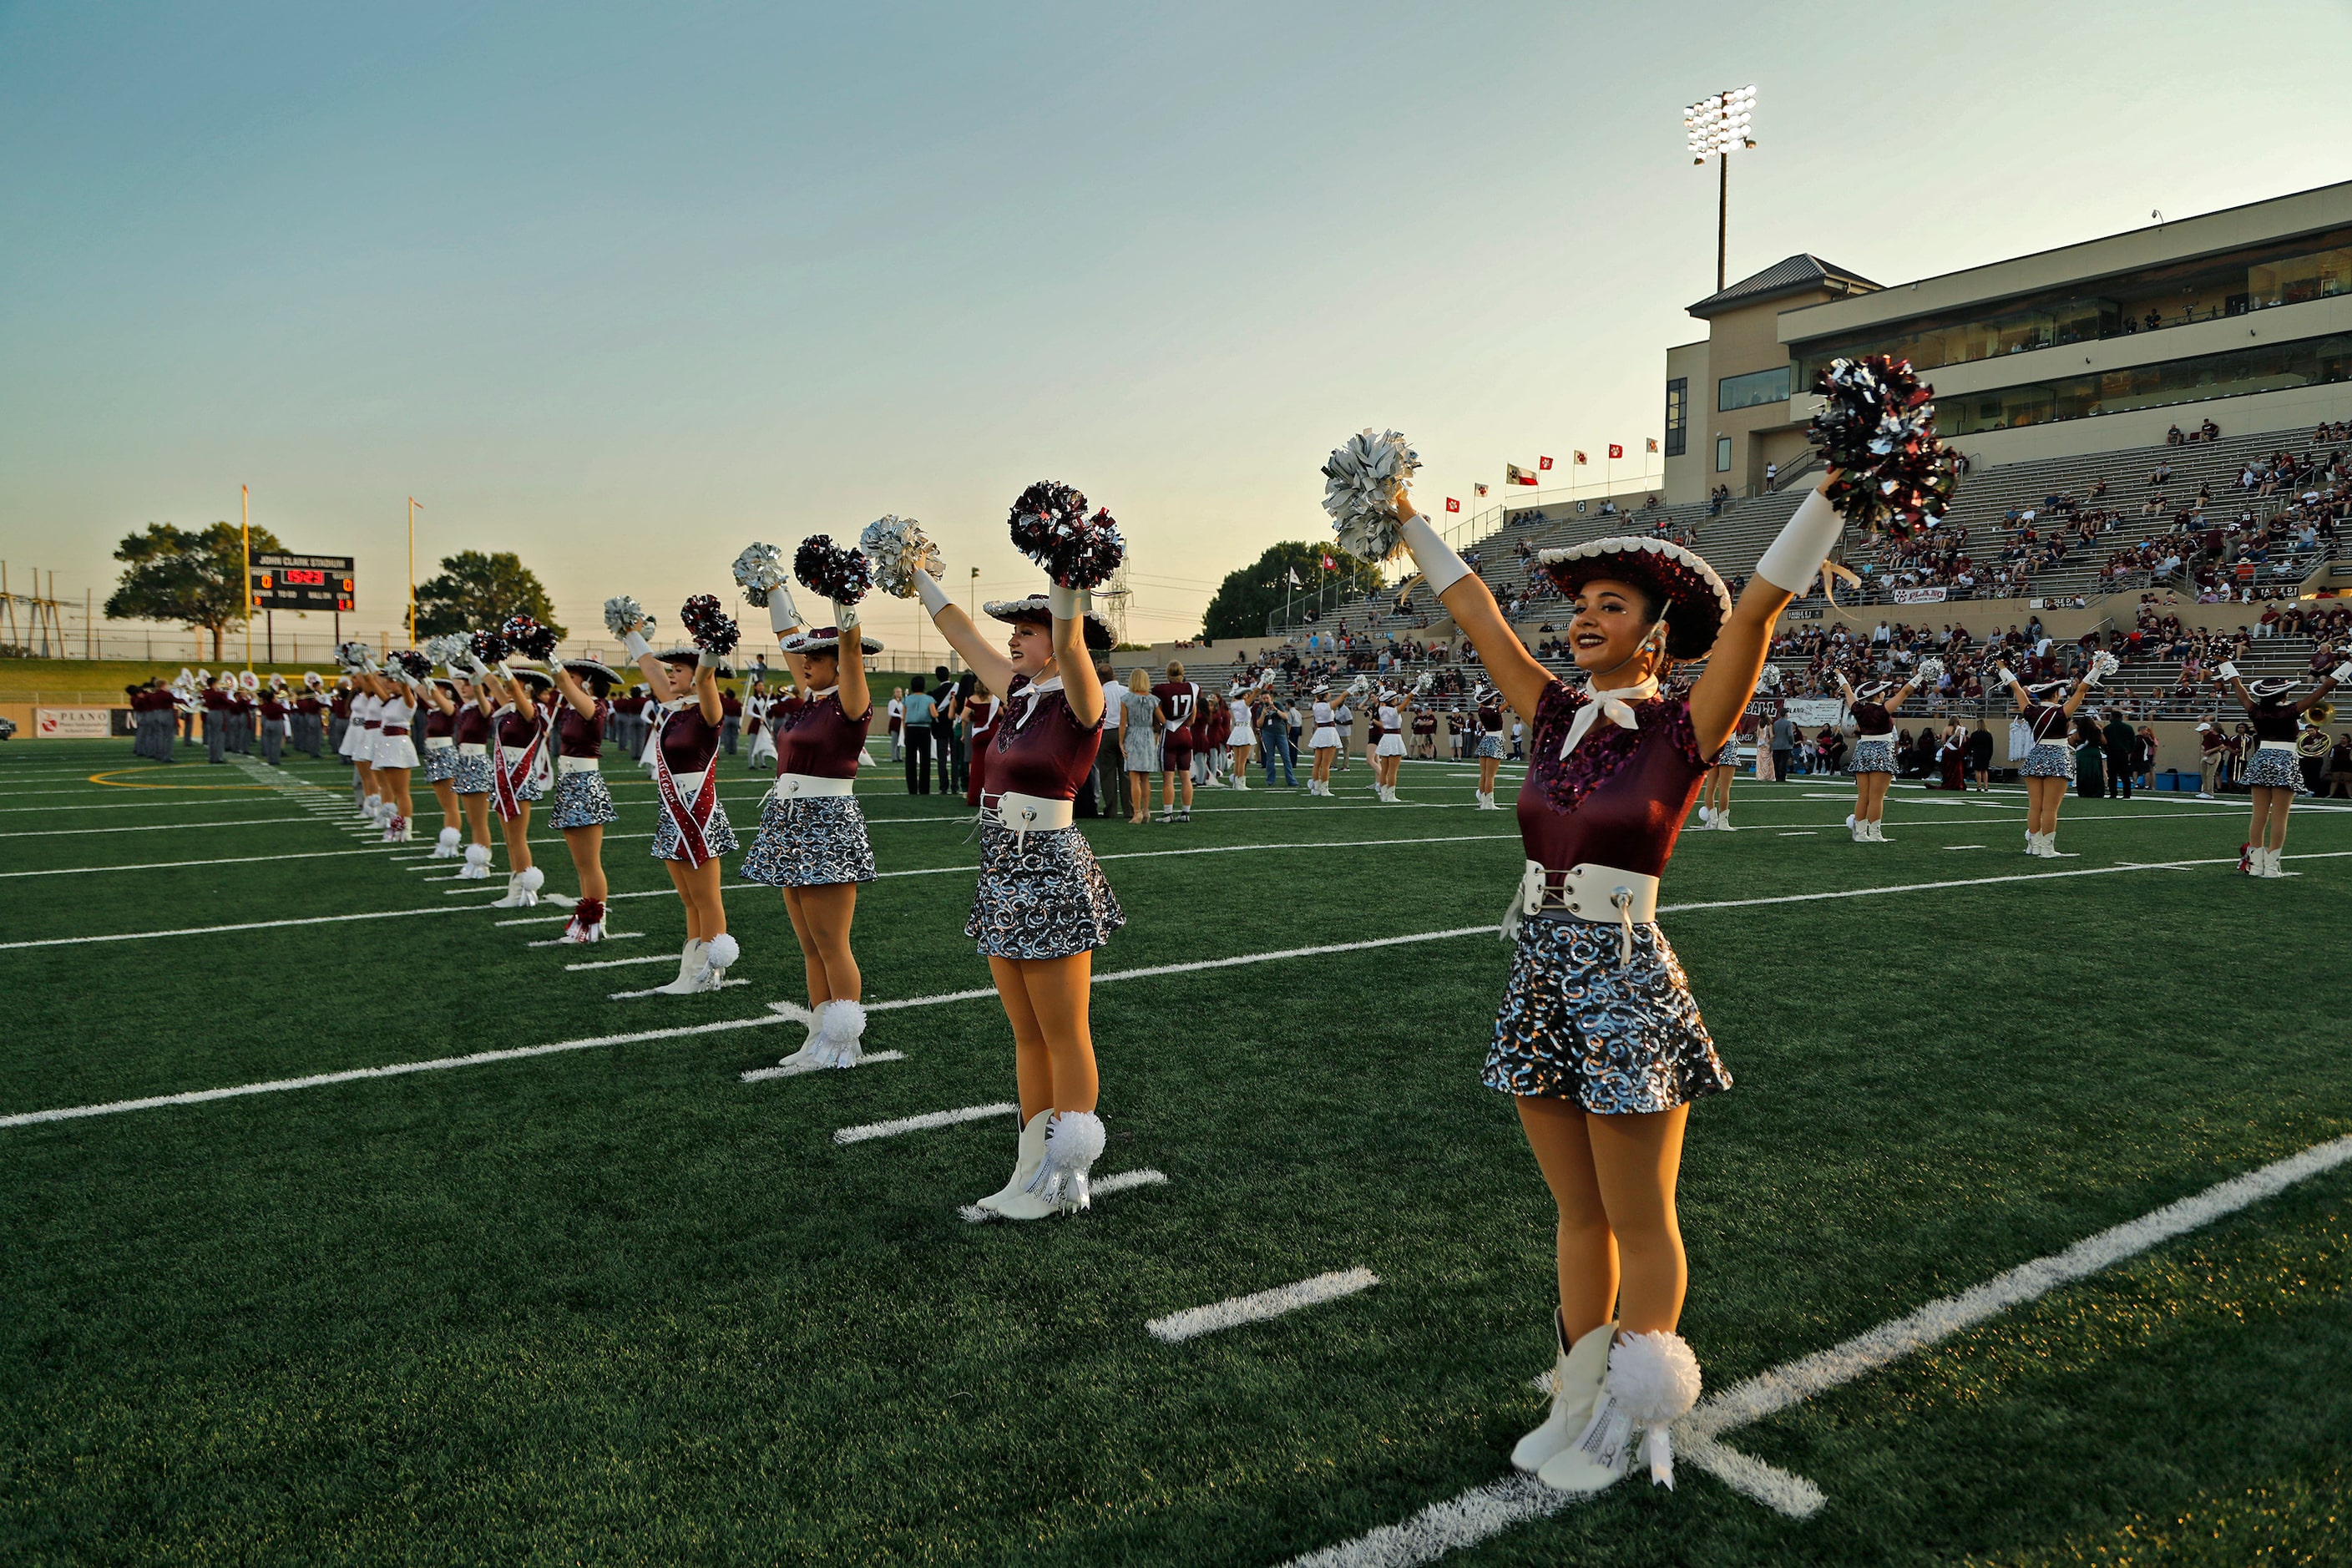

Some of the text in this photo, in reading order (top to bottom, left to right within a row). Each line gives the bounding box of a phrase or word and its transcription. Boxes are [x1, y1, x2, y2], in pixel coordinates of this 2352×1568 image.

[1577, 501, 1585, 513] G
[259, 556, 346, 568] JOHN CLARK STADIUM
[260, 574, 273, 589] 0
[342, 578, 353, 592] 0
[1909, 589, 1945, 600] PLANO
[1171, 694, 1191, 716] 17
[1744, 701, 1778, 718] BALL
[61, 712, 107, 721] PLANO
[661, 773, 675, 802] Team
